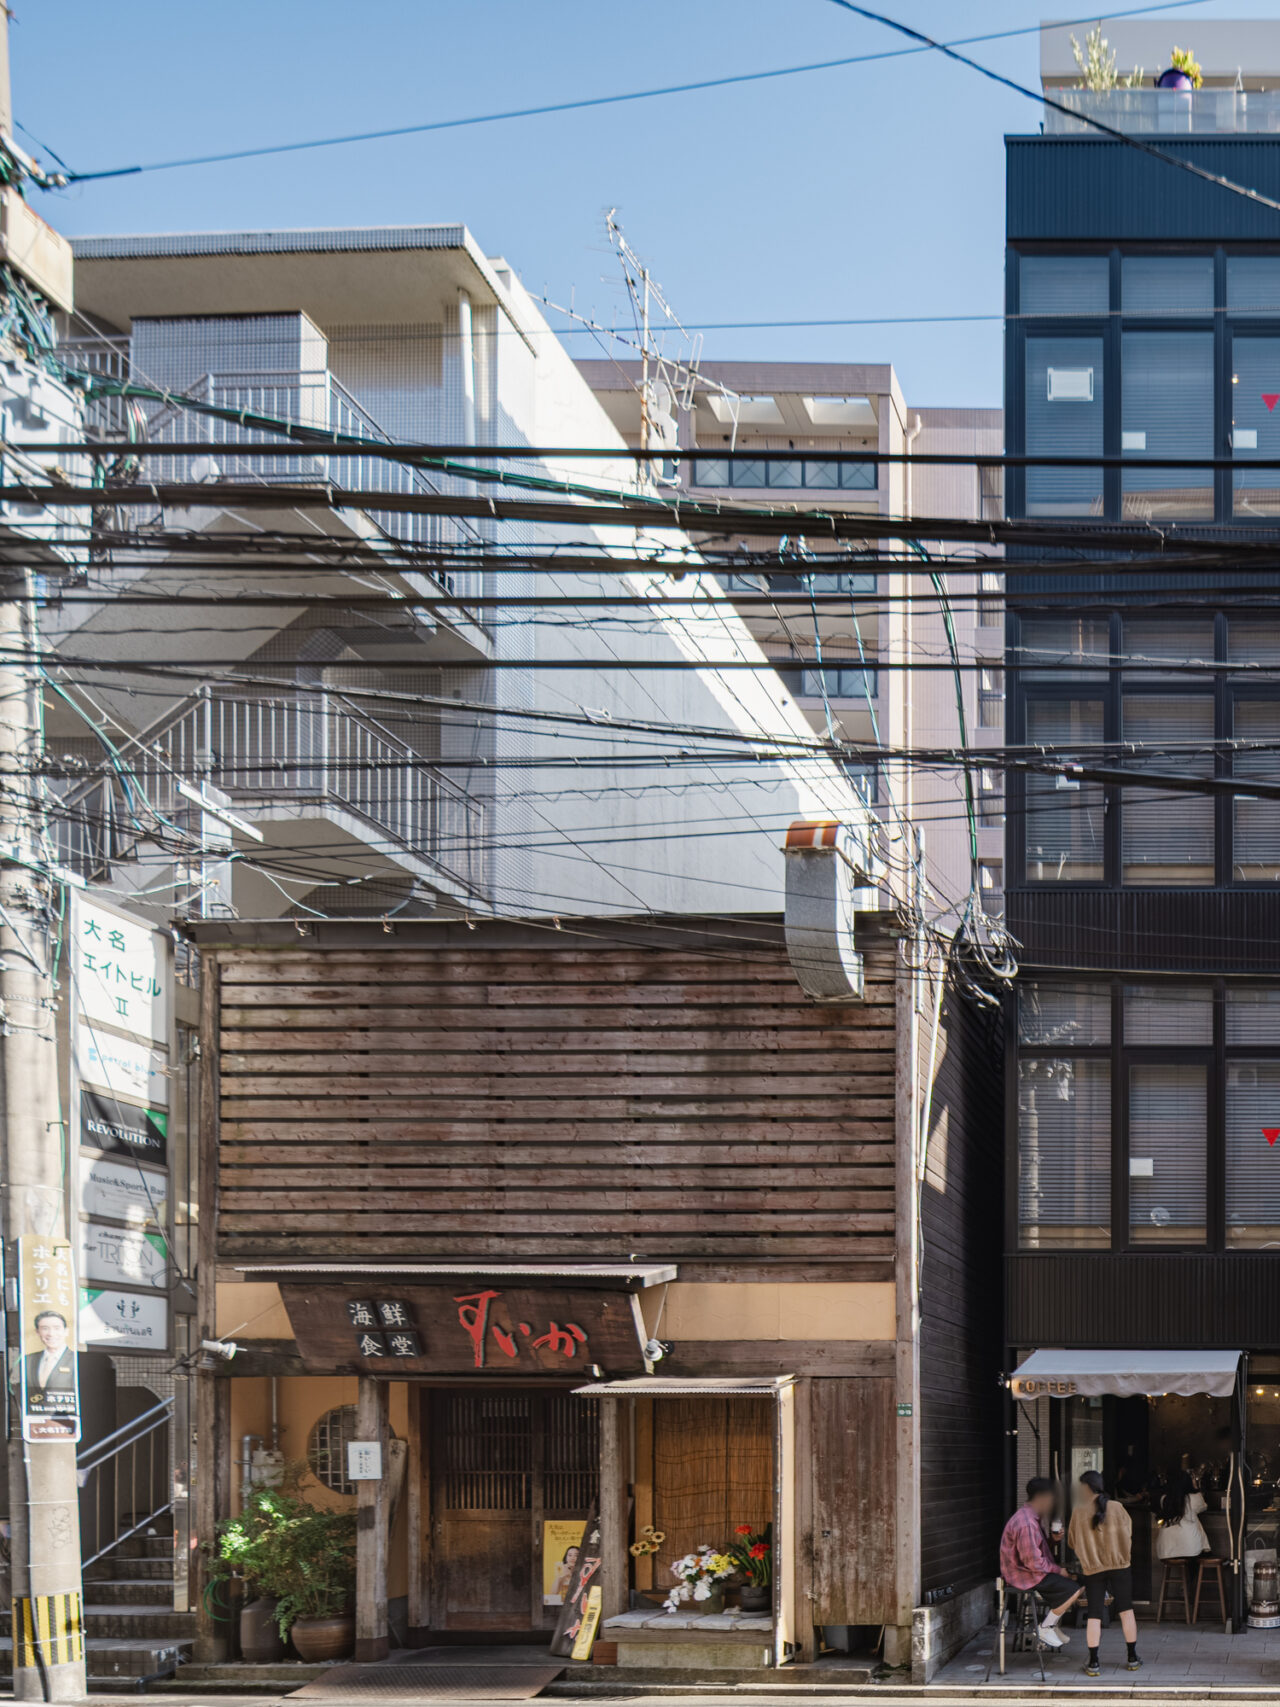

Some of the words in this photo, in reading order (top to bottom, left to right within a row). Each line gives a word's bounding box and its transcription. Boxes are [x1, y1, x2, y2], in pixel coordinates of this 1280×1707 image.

[84, 919, 126, 952] 大名
[83, 952, 162, 997] エイトビル
[86, 1118, 161, 1149] REVOLUTION
[32, 1244, 53, 1304] ホテリエ
[349, 1303, 407, 1327] 海鮮
[453, 1290, 589, 1369] すいか
[360, 1333, 416, 1358] 食堂
[1017, 1380, 1077, 1393] COFFEE
